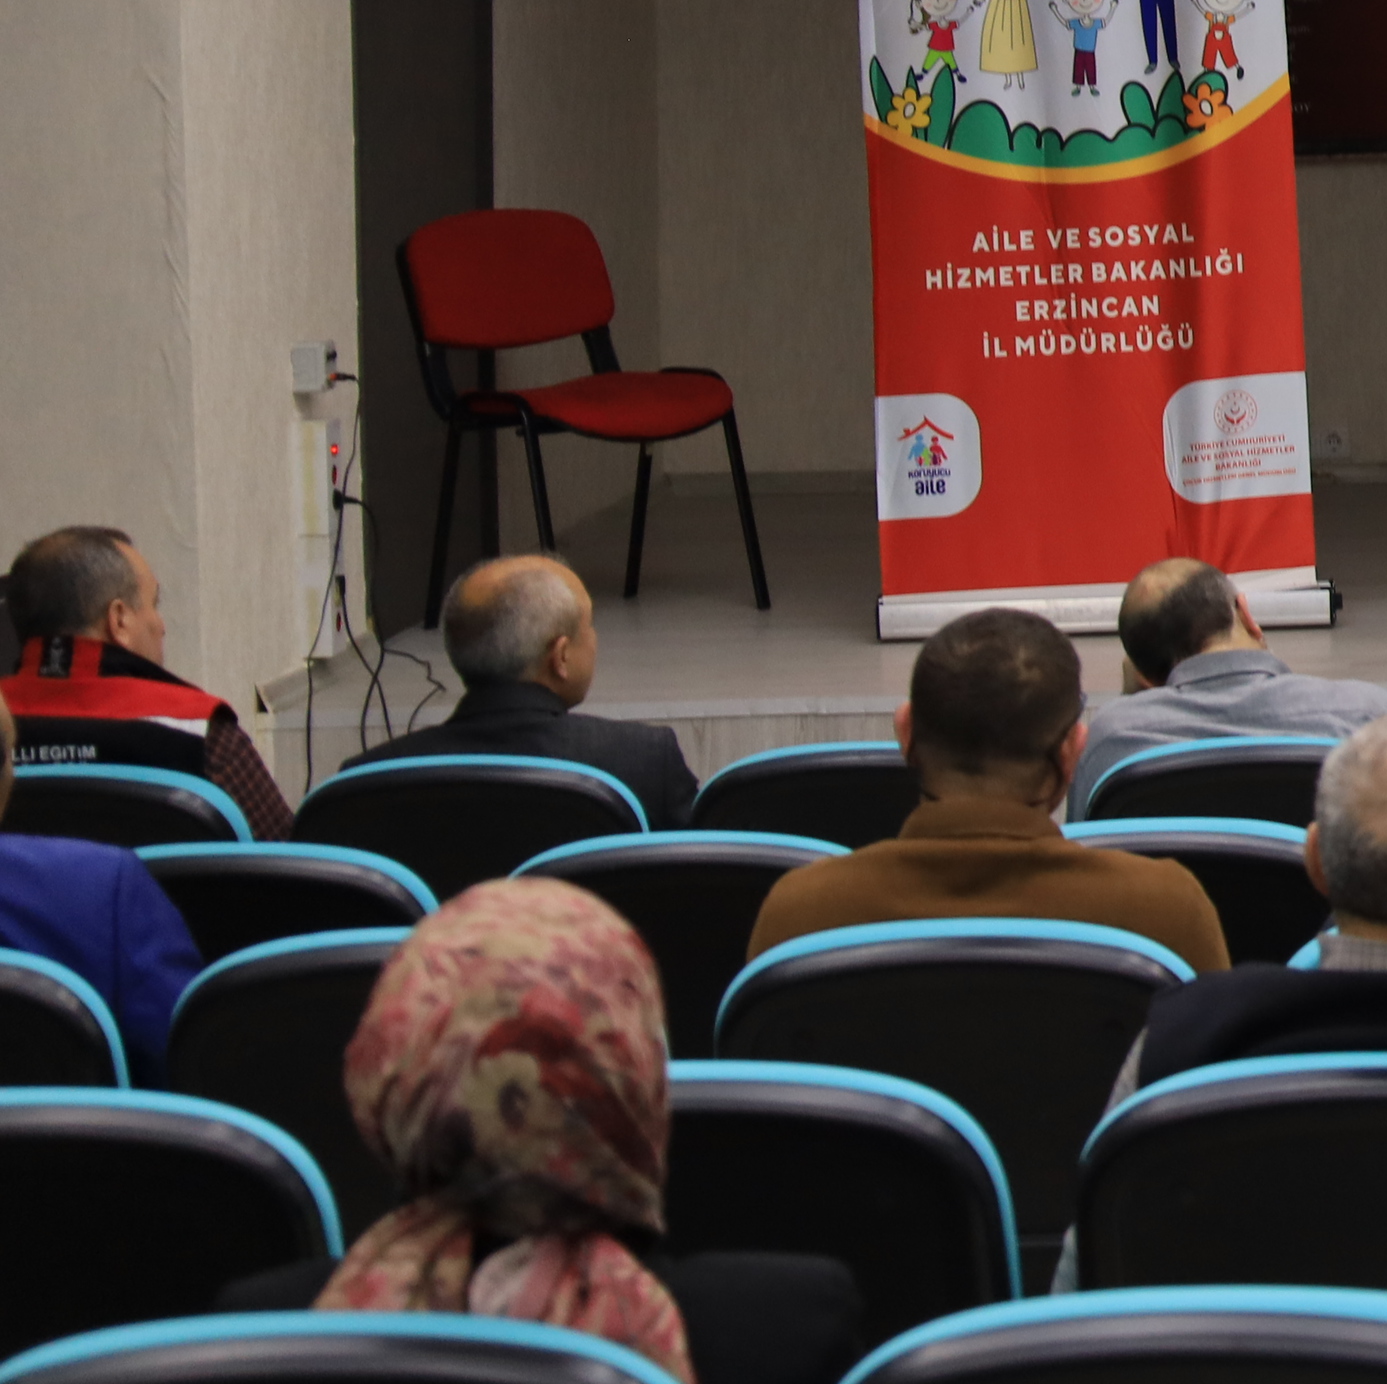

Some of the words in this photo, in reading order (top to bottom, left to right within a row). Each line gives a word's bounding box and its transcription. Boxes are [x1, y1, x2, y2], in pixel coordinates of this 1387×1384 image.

[972, 225, 1035, 253] AİLE
[1047, 228, 1081, 249] VE
[1088, 222, 1195, 247] SOSYAL
[925, 262, 1084, 290] HİZMETLER
[1092, 248, 1244, 283] BAKANLIĞI
[1016, 292, 1160, 321] ERZİNCAN
[983, 332, 1007, 358] İL
[1015, 323, 1194, 356] MÜDÜRLÜĞÜ
